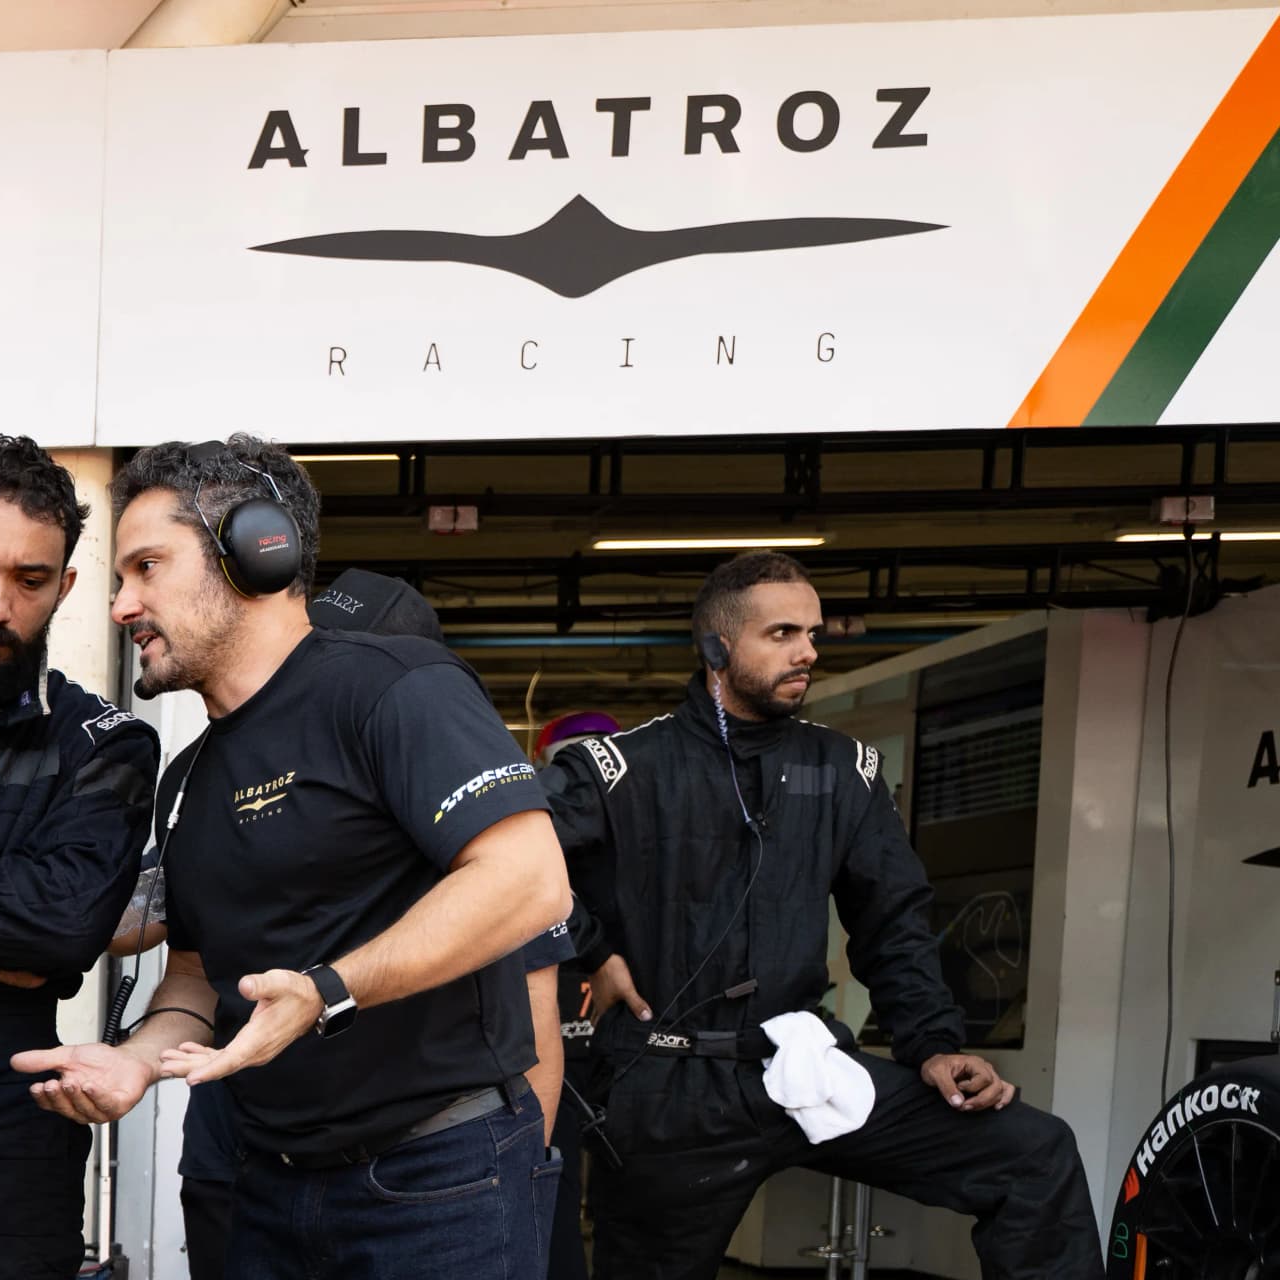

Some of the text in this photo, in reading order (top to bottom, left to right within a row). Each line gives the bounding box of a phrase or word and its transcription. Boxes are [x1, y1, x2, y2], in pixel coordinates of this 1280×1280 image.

[247, 86, 931, 170] ALBATROZ
[328, 332, 836, 376] RACING
[234, 771, 296, 803] ALBATROZ
[475, 774, 533, 798] PRO SERIES
